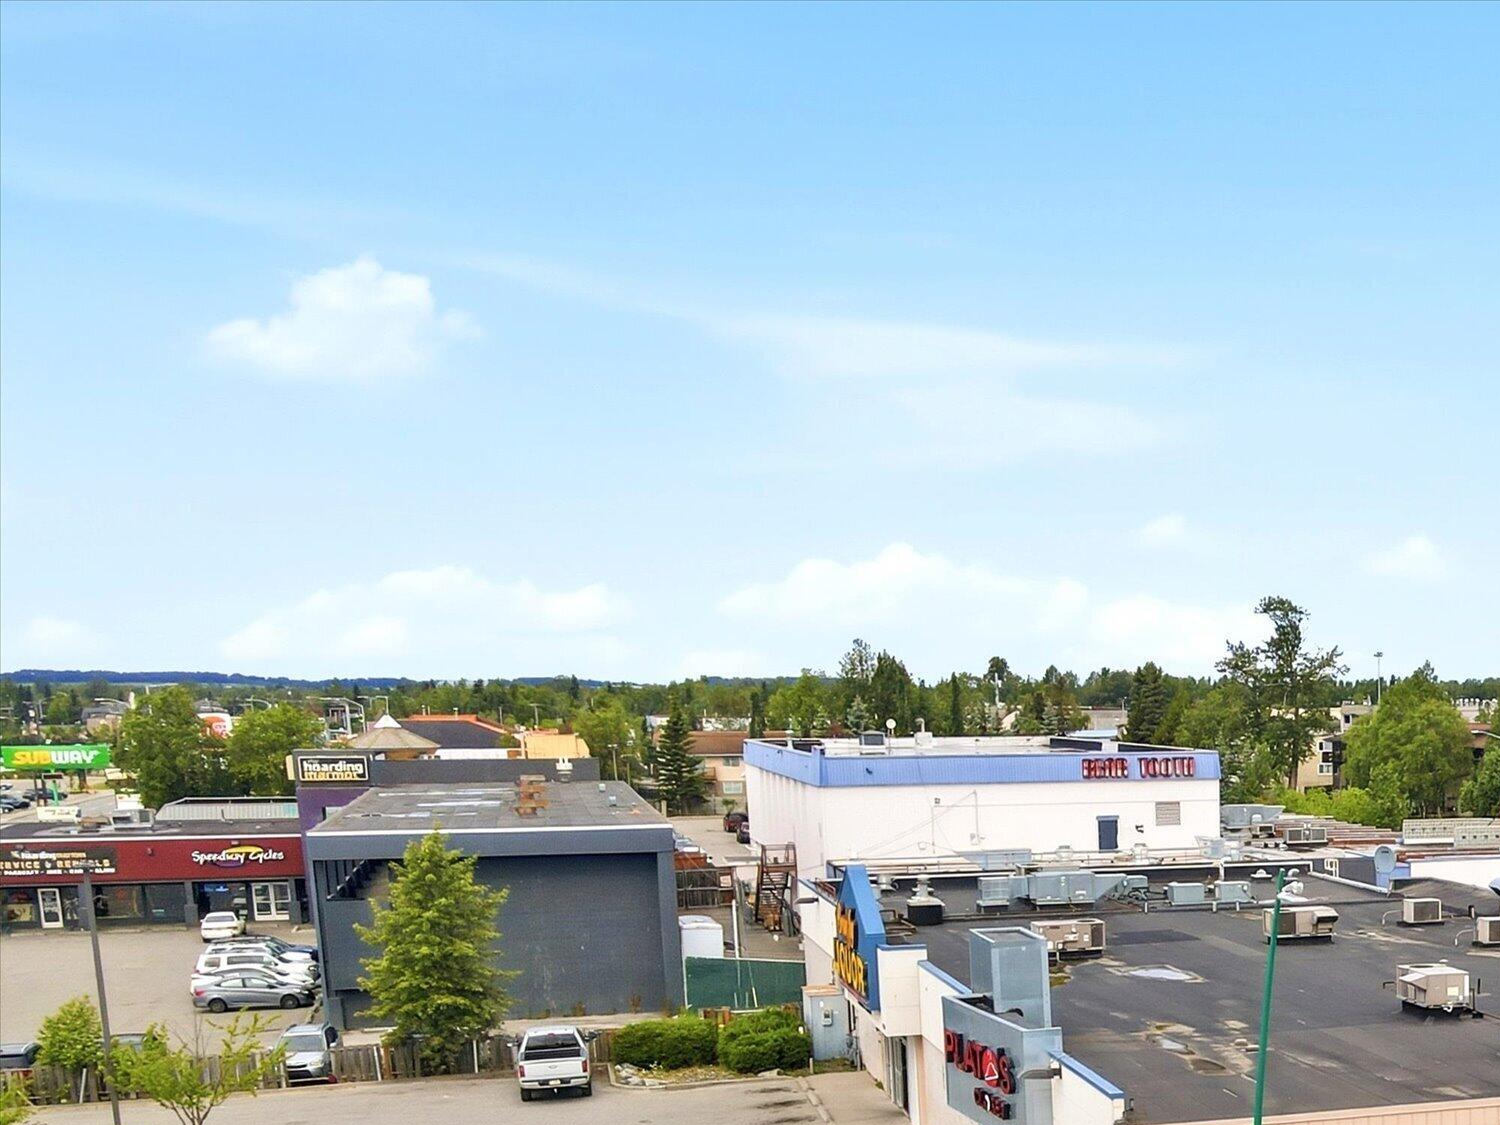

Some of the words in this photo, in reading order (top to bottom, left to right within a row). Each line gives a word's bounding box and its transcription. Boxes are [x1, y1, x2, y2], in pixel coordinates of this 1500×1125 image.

[12, 750, 99, 765] SUBWAY
[303, 760, 363, 774] hoarding
[191, 850, 245, 865] Speedway
[249, 849, 284, 863] Cycles
